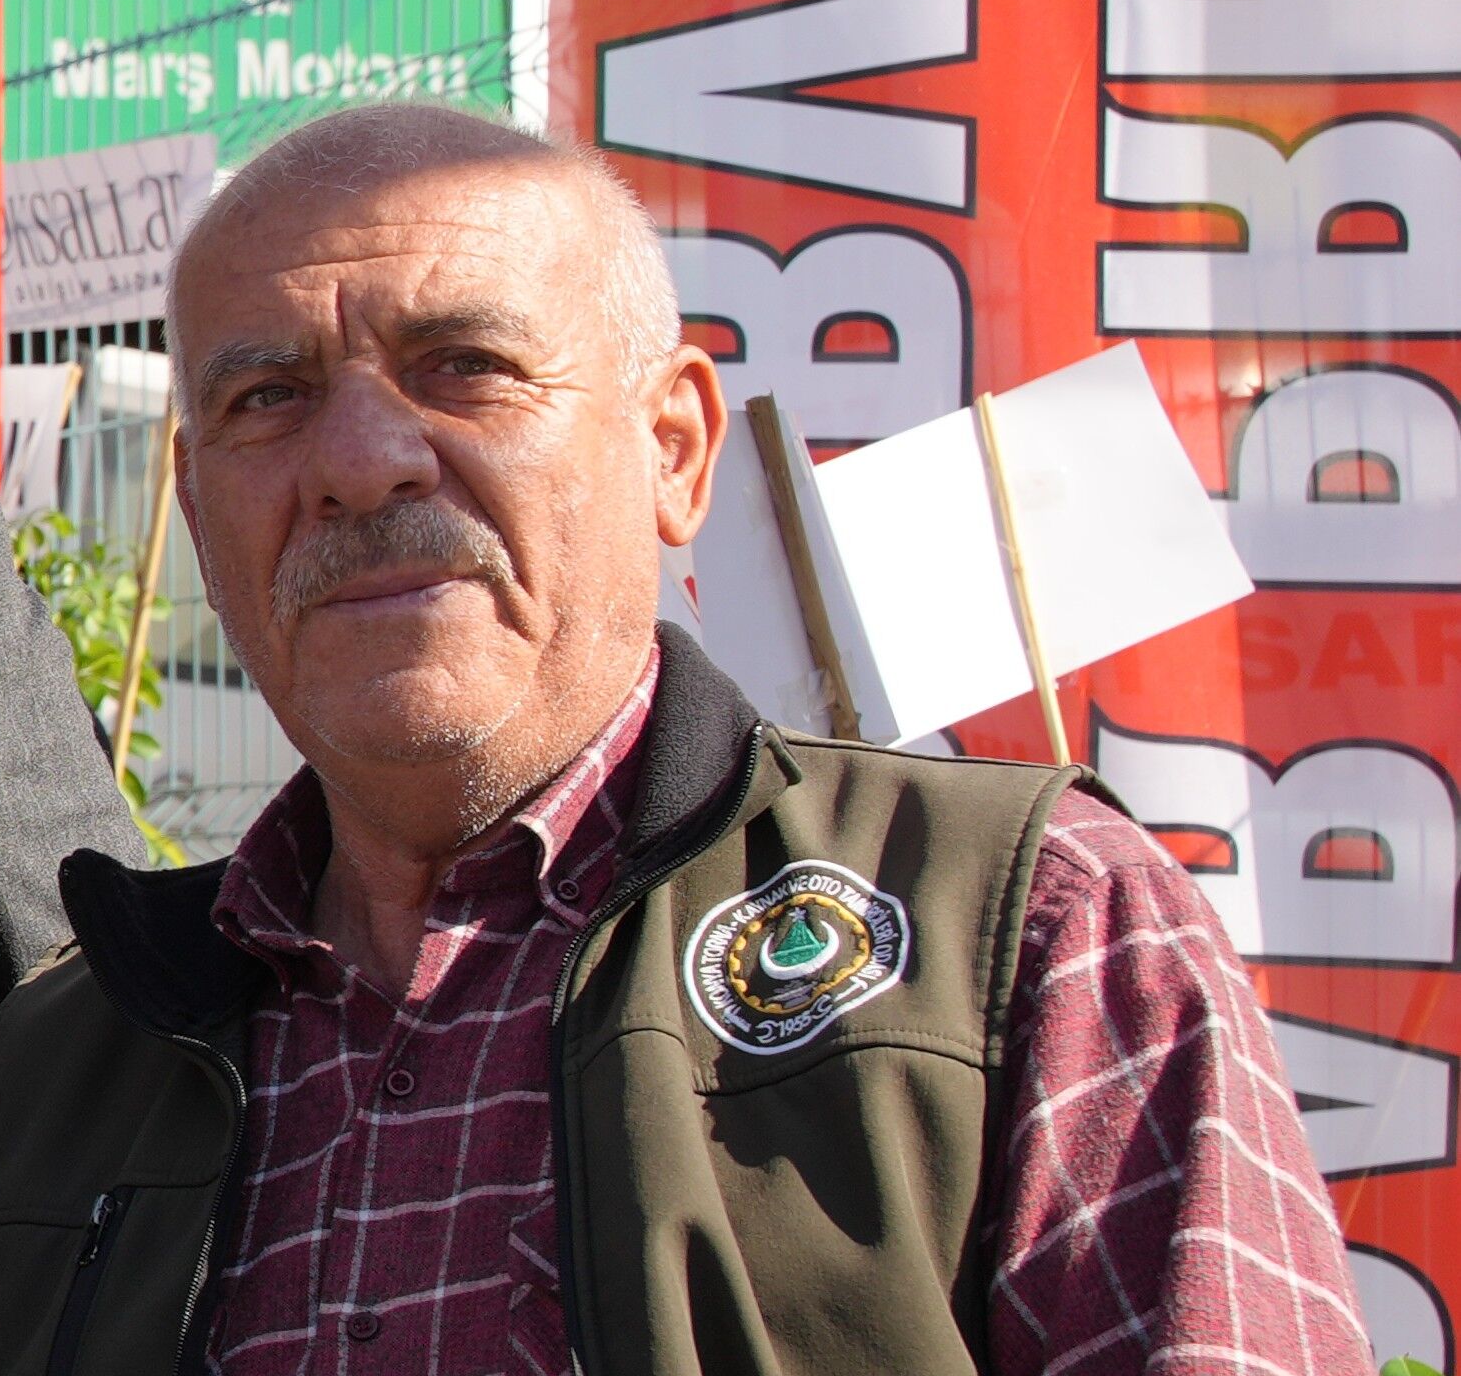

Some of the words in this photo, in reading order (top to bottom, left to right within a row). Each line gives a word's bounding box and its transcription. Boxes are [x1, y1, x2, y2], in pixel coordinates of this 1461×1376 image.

[51, 37, 215, 114] Marş
[788, 875, 809, 893] VE
[808, 874, 842, 895] OTO
